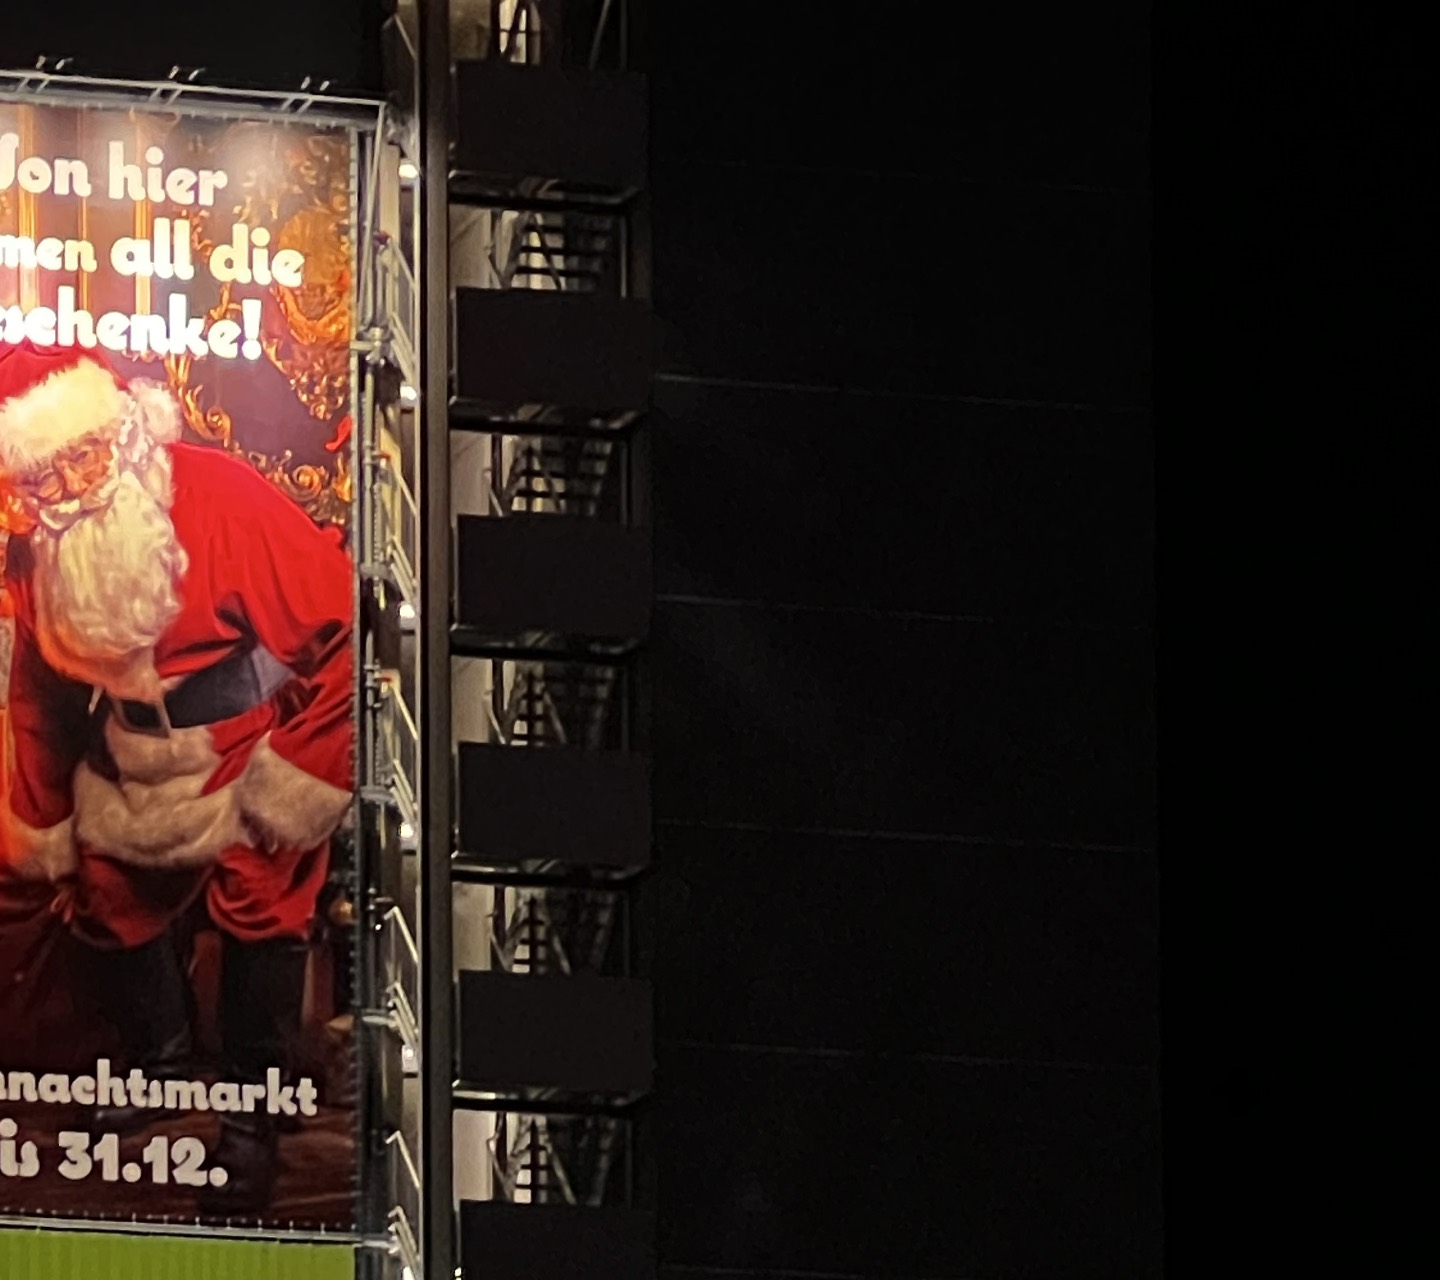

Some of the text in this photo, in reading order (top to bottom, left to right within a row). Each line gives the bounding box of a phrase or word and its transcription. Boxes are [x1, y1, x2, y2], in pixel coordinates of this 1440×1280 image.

[108, 141, 228, 206] hier
[110, 217, 194, 281] all
[209, 227, 305, 288] die
[58, 1131, 228, 1187] 31.12.
